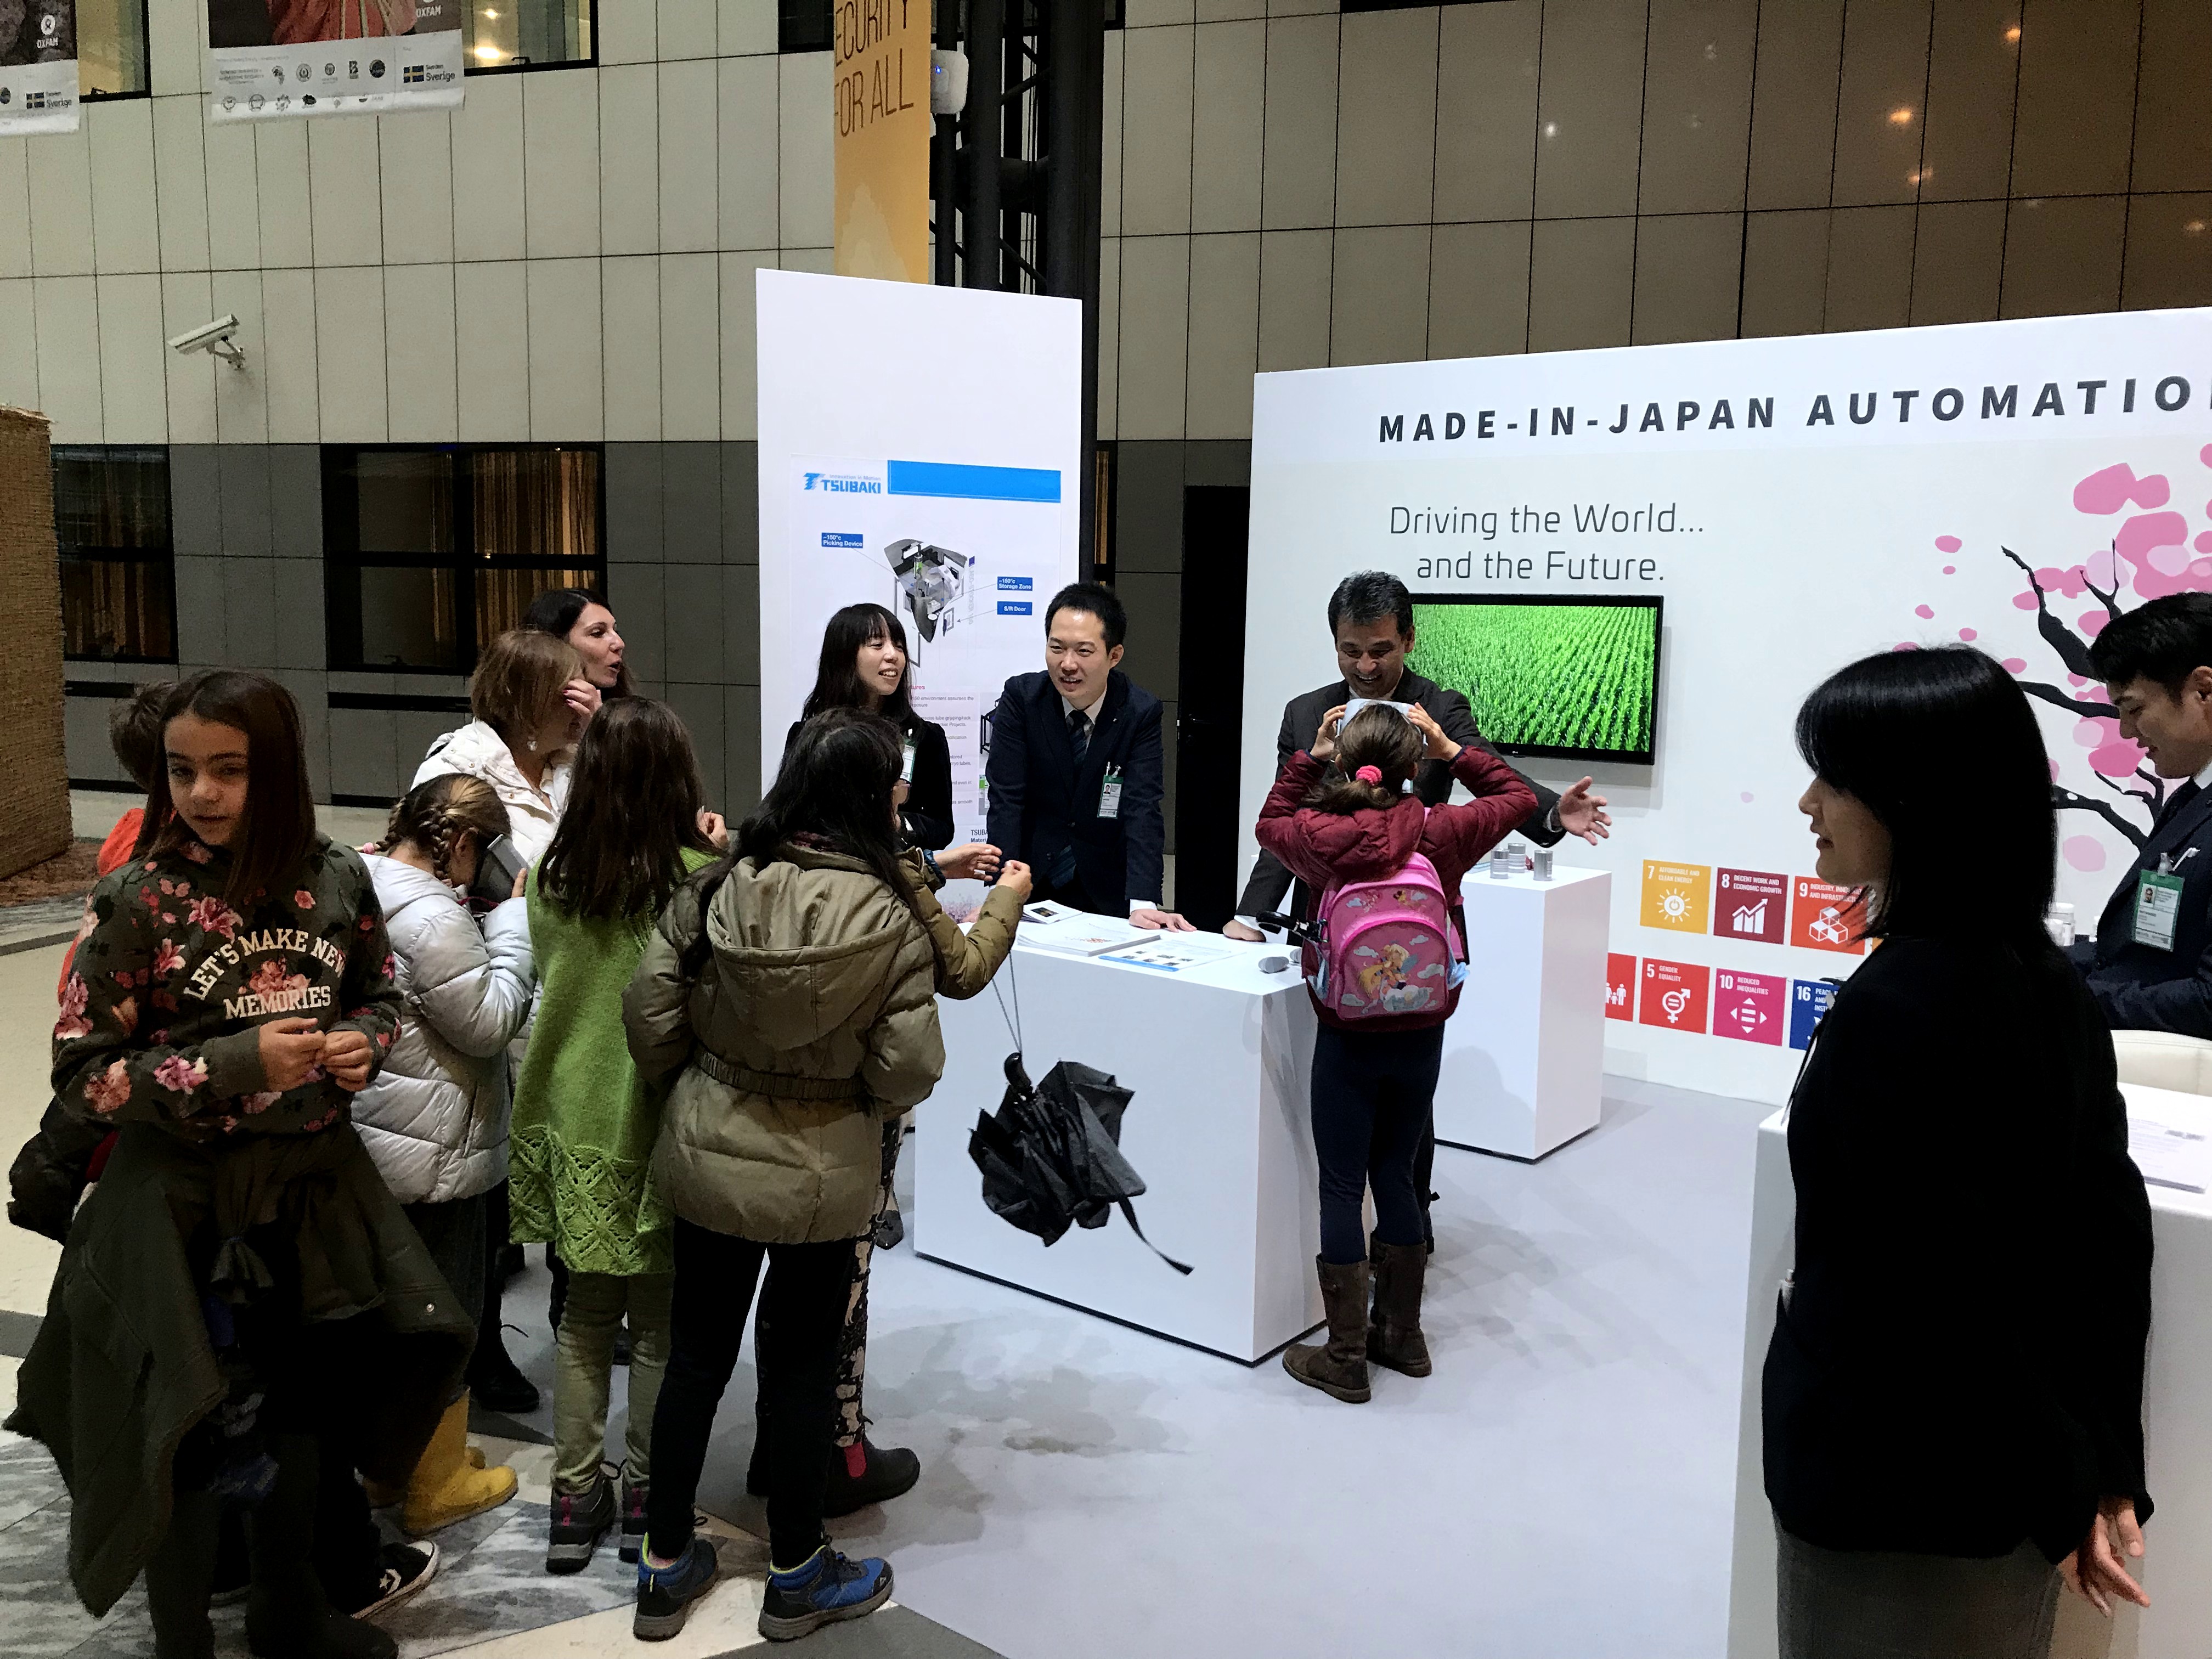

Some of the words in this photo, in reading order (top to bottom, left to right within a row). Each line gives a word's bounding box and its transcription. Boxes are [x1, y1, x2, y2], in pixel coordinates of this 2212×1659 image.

[416, 5, 442, 18] OXFAM
[37, 37, 58, 48] OXFAM
[426, 71, 455, 82] Sverige
[871, 48, 914, 123] ALL
[47, 99, 72, 108] Sverige
[1379, 397, 1775, 443] MADE-IN-JAPAN
[1806, 376, 2212, 426] AUTOMATIO
[820, 479, 881, 494] TSUBAKI
[1390, 506, 1498, 540] Driving
[1510, 505, 1561, 534] the
[1573, 503, 1704, 533] World...
[1417, 551, 1471, 579] and
[1484, 551, 1533, 579] the
[1547, 550, 1665, 581] Future.
[1647, 865, 1655, 879] 7
[1722, 873, 1730, 888] 8
[1733, 883, 1759, 891] ECONOMIC
[1760, 886, 1782, 894] GROWTH
[1799, 882, 1808, 897] 9
[183, 943, 240, 1000] LET'S
[238, 928, 309, 956] MAKE
[1646, 963, 1655, 978] 5
[1658, 966, 1678, 974] GENDER
[1658, 973, 1681, 982] EQUALITY
[1719, 974, 1734, 990] 10
[1737, 977, 1760, 985] REDUCED
[1736, 985, 1769, 995] INEQUALITIES
[1797, 985, 1812, 1001] 16
[223, 986, 331, 1019] MEMORIES
